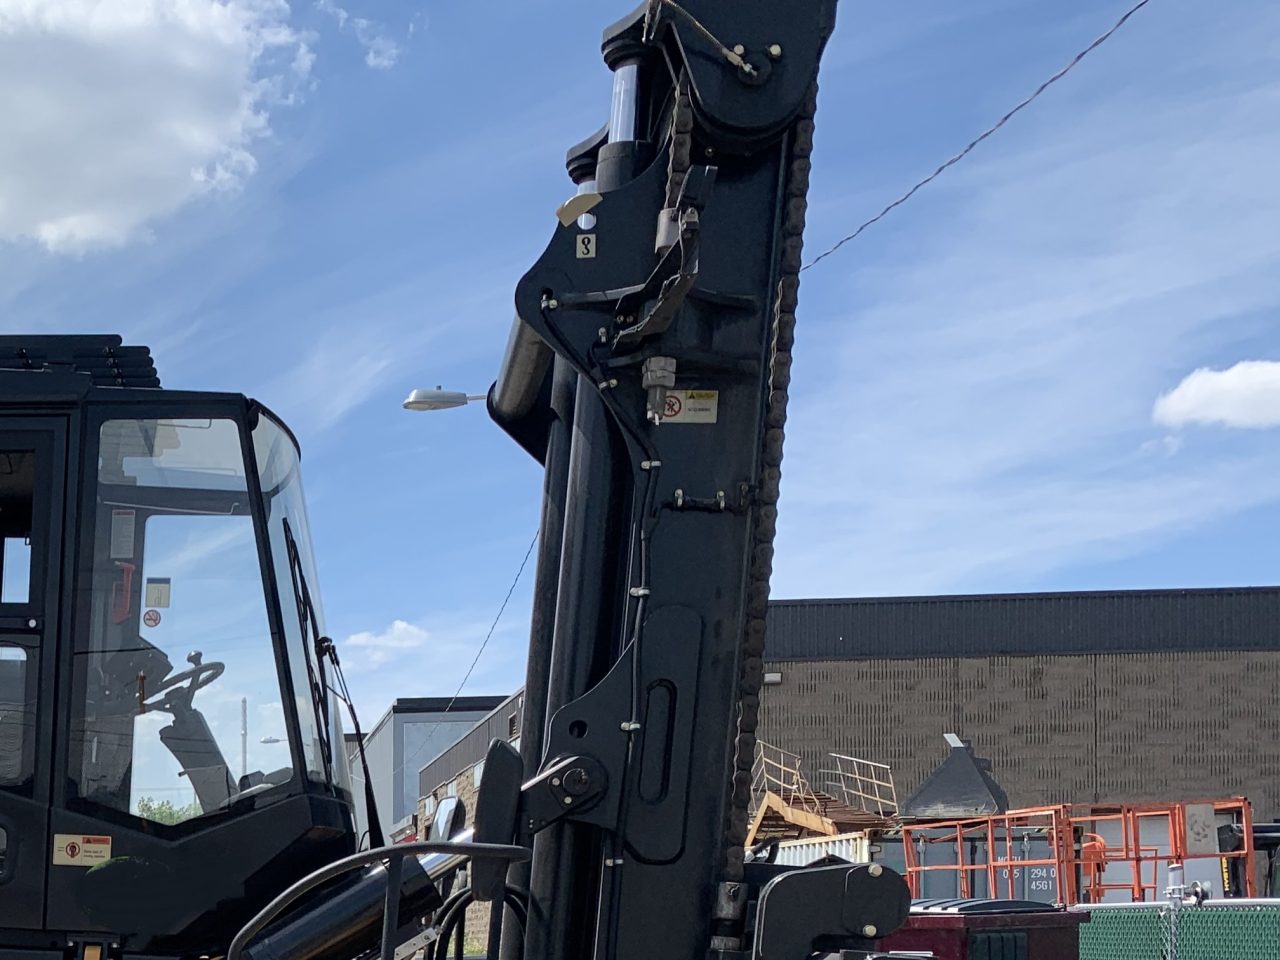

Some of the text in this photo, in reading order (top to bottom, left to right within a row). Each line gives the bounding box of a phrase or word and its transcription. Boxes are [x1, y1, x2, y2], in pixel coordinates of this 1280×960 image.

[1003, 868, 1056, 879] 05 294 0
[1031, 880, 1052, 890] 45G1
